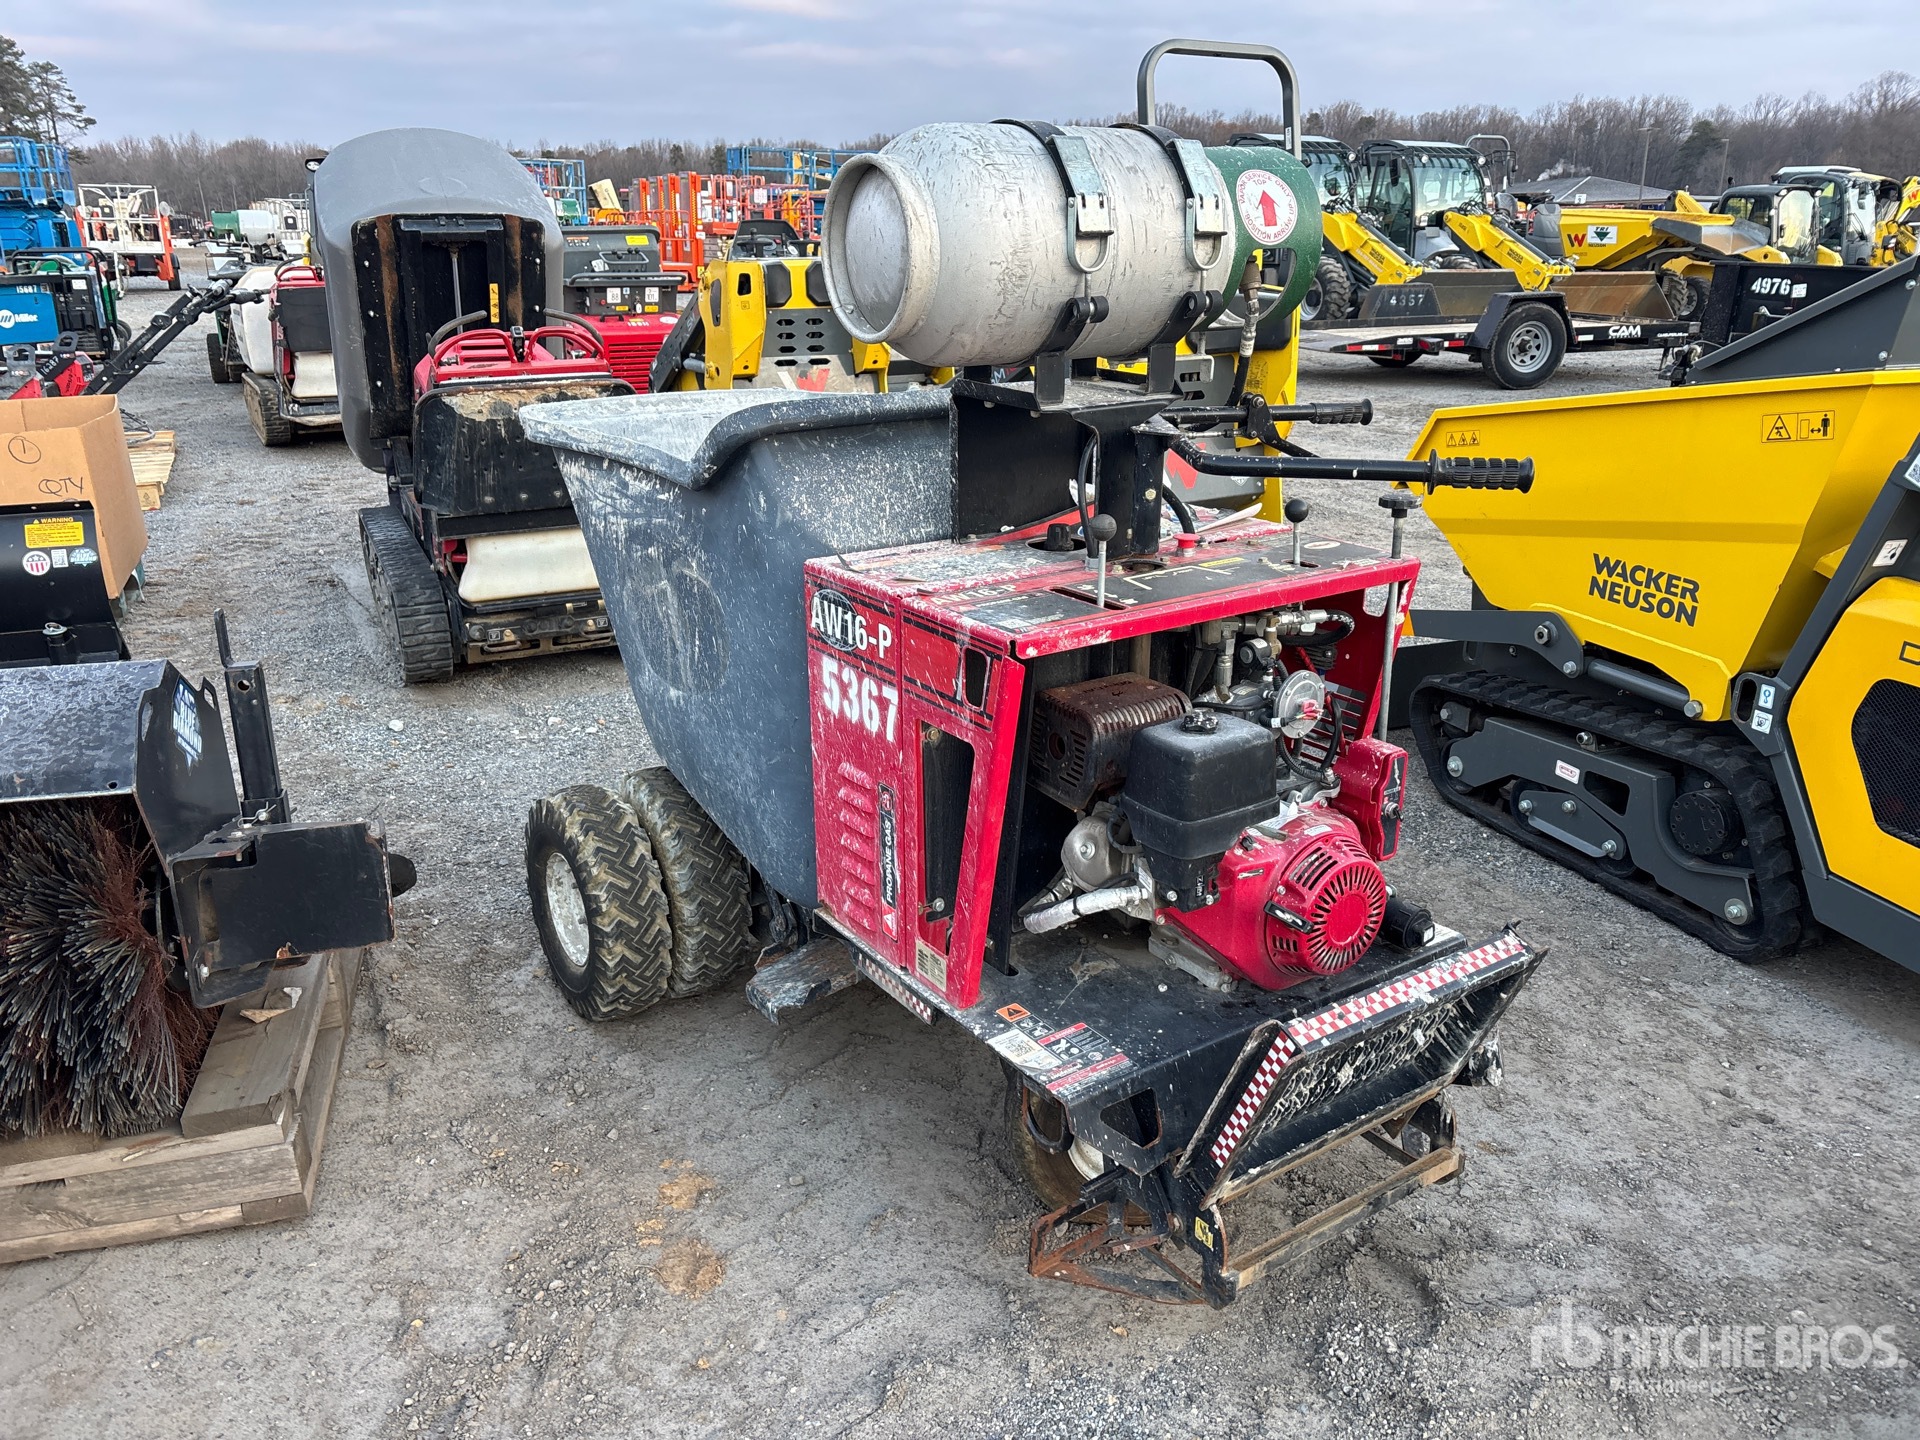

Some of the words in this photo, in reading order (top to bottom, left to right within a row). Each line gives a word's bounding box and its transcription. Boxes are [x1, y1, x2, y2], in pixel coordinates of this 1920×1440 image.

[1238, 180, 1247, 204] VAPOR
[1245, 173, 1272, 182] SERVICE
[1275, 180, 1292, 197] ONLY
[1288, 203, 1295, 215] UP
[16, 285, 37, 294] 15687
[1751, 277, 1791, 296] 4976
[1389, 294, 1425, 307] 4357
[15, 313, 38, 323] Miller
[1608, 324, 1642, 337] CAM
[40, 355, 59, 376] 16287
[38, 476, 84, 497] QTY
[1592, 552, 1700, 604] WACKER
[1588, 576, 1698, 627] NEUSON
[811, 596, 893, 659] AW16-P
[821, 655, 899, 742] 5367
[885, 847, 893, 903] PROPANE
